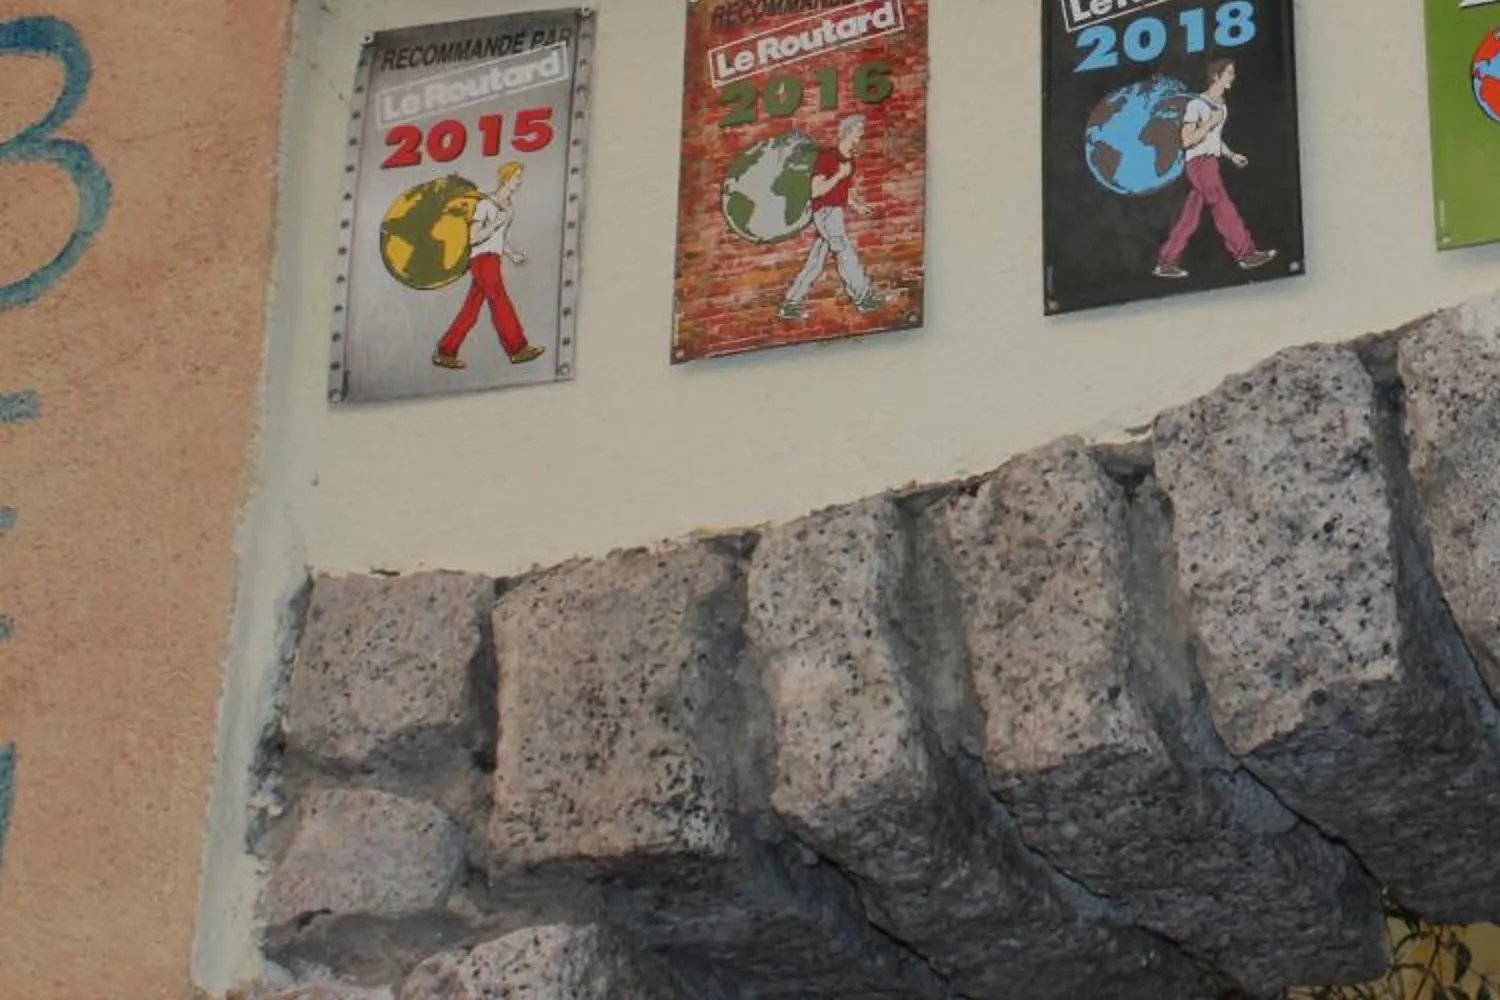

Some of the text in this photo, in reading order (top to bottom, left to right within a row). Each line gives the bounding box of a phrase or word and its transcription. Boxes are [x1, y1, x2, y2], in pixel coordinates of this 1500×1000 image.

[380, 29, 526, 72] RECOMMANDÉ
[716, 1, 896, 78] Le Routard
[1073, 0, 1256, 72] 2018
[384, 51, 563, 119] Le Routard
[718, 60, 895, 129] 2016
[380, 107, 555, 170] 2015
